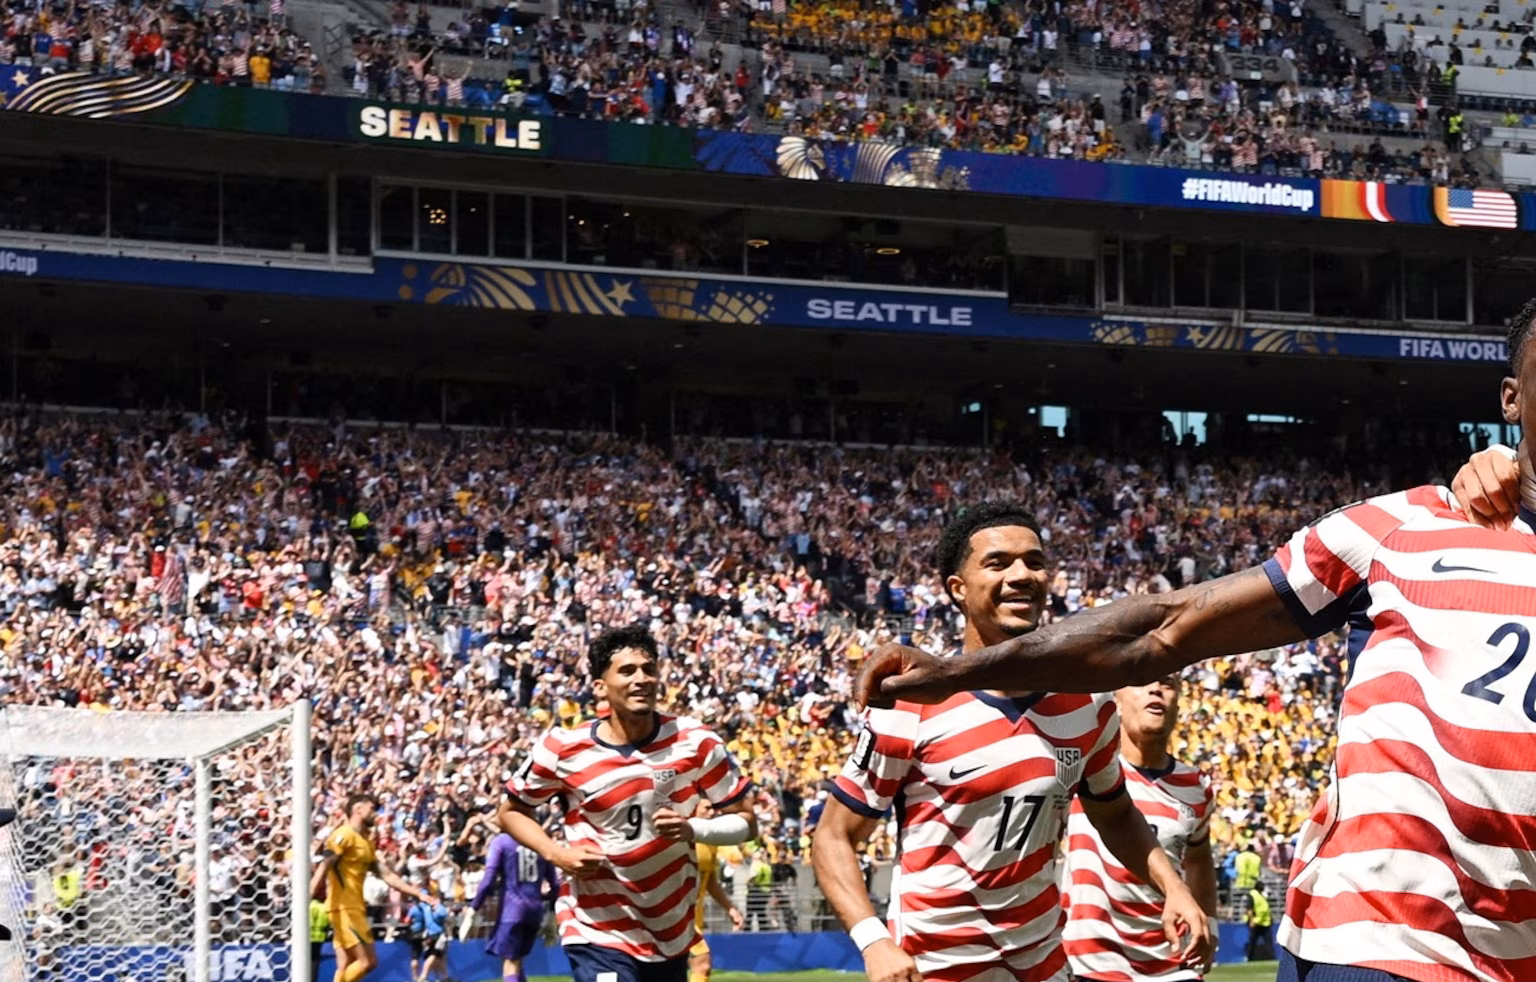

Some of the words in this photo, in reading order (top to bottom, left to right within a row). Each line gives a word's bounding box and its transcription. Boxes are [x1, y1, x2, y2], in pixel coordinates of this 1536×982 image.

[1229, 55, 1280, 73] 334
[360, 106, 541, 150] SEATTLE
[1181, 177, 1314, 212] #FIFAWorldCup
[807, 298, 973, 326] SEATTLE
[1400, 338, 1445, 358] FIFA
[1447, 340, 1509, 361] WORL
[1057, 750, 1079, 766] USA
[654, 770, 674, 782] USA
[627, 804, 643, 841] 9
[993, 795, 1046, 851] 17
[516, 844, 538, 882] 18
